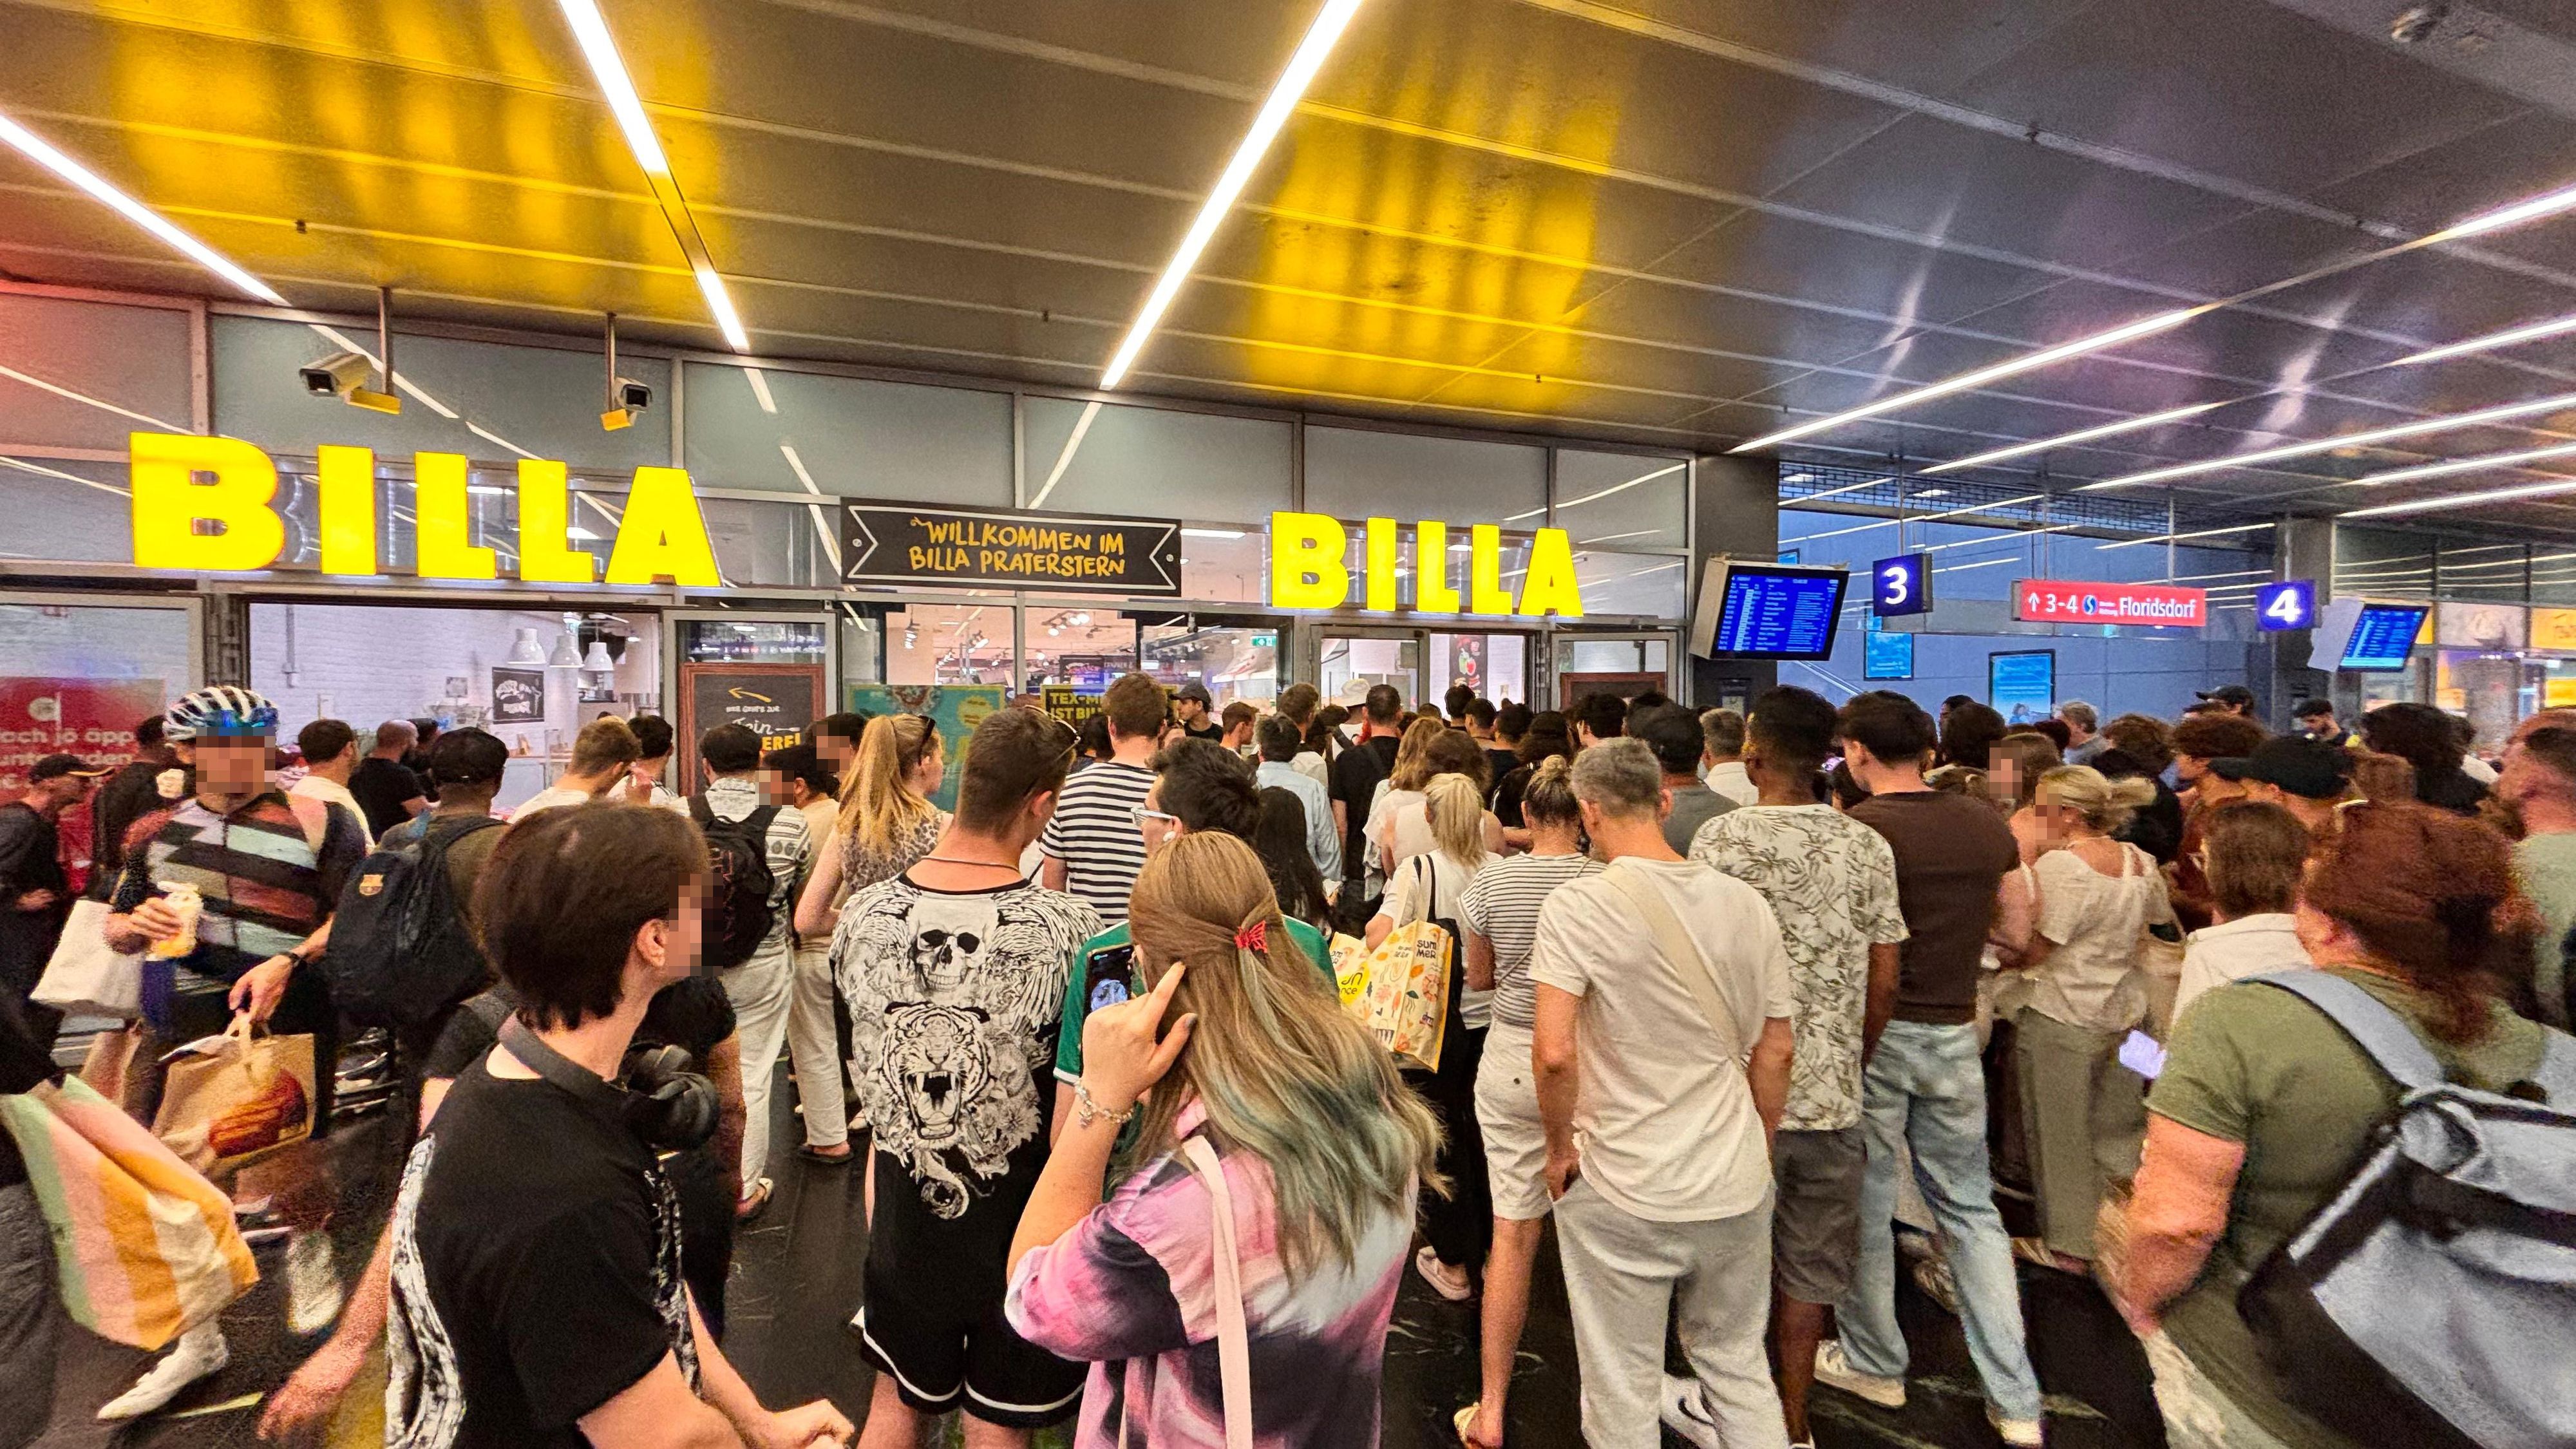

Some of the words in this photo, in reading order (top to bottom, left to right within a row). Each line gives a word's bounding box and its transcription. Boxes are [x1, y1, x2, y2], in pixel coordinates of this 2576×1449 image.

[129, 431, 721, 586] BILLA
[910, 516, 1092, 553] WILLKOMMEN
[1099, 533, 1124, 556] IM
[909, 545, 971, 572] BILLA
[980, 549, 1125, 578] PRATERSTERN
[1272, 511, 1584, 617] BILLA
[1884, 566, 1908, 605] 3
[2045, 593, 2078, 614] 3-4
[2119, 596, 2197, 618] Floridsdorf
[2266, 589, 2302, 623] 4
[1050, 692, 1103, 705] TEX-M
